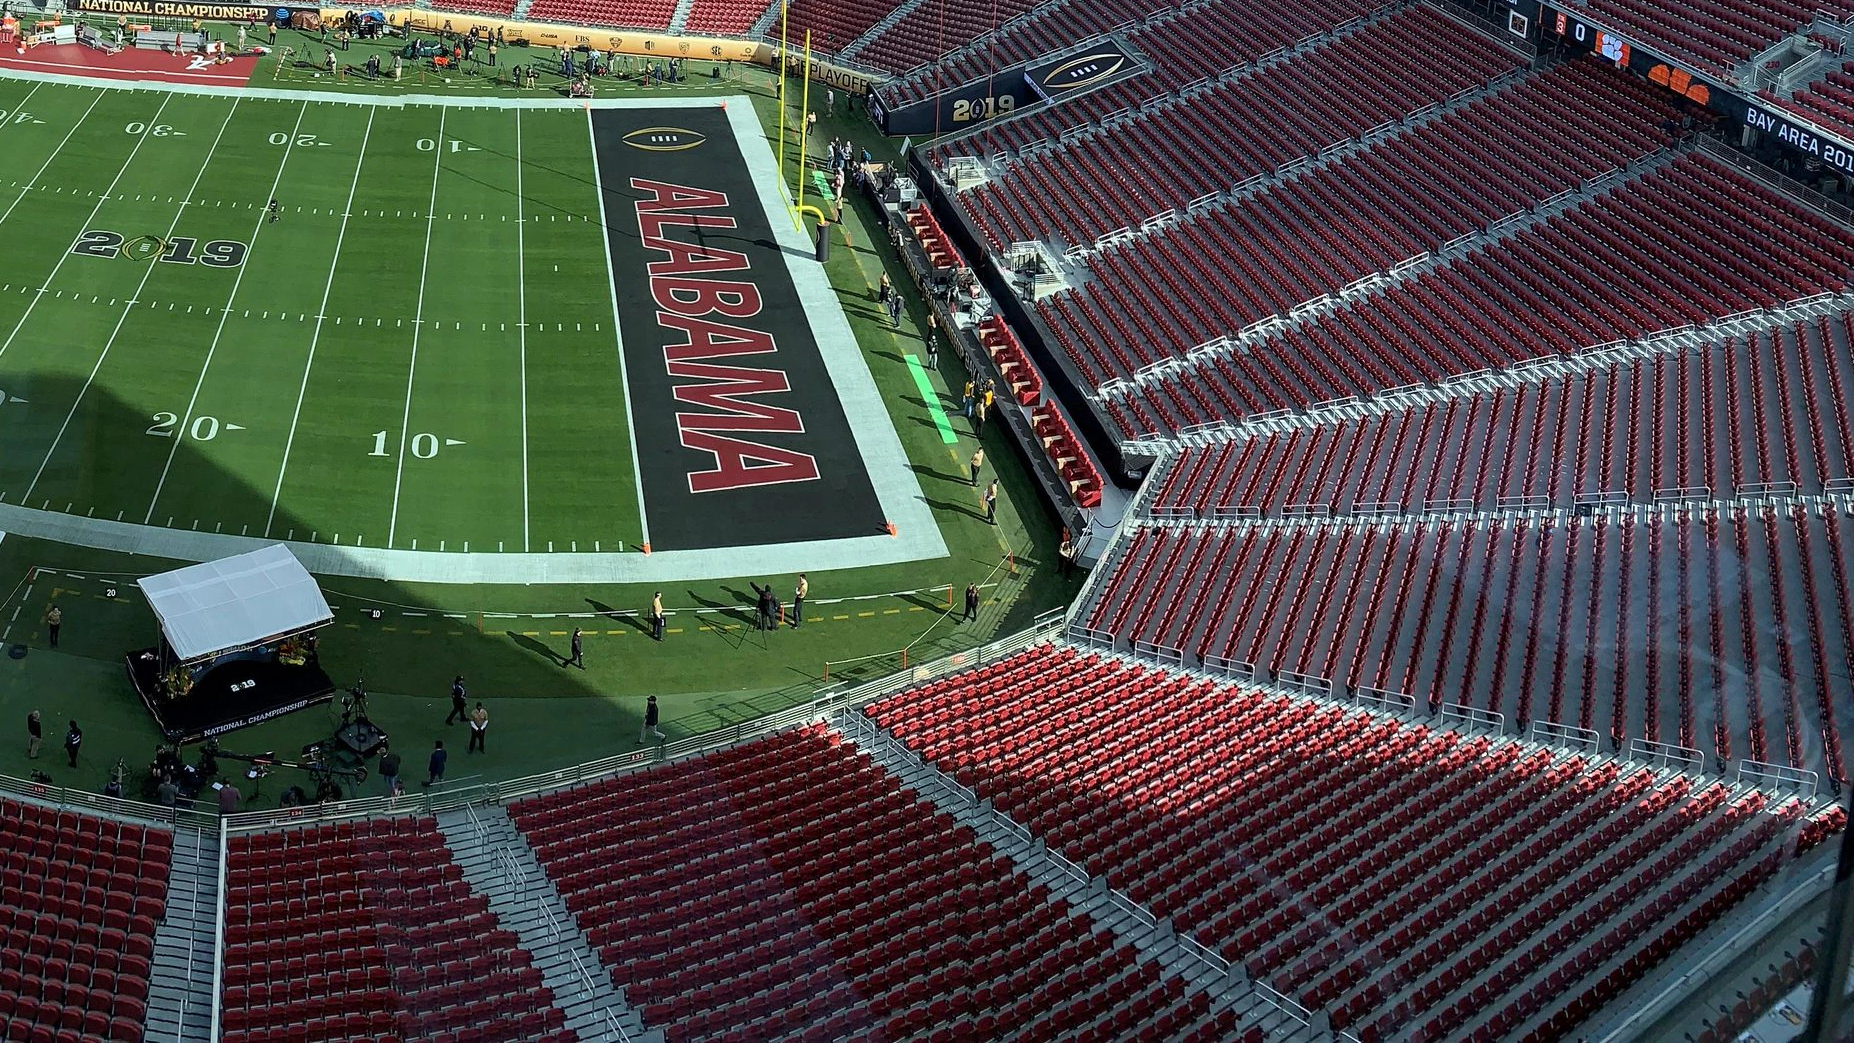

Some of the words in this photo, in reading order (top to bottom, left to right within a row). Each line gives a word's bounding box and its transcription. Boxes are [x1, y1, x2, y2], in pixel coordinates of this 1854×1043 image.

[154, 1, 269, 21] CHAMPIONSHIP
[1575, 22, 1586, 42] 0
[953, 93, 1015, 122] 2019
[1747, 107, 1776, 132] BAY
[1778, 123, 1819, 156] AREA
[70, 230, 248, 268] 2019
[629, 177, 822, 494] ALABAMA
[145, 411, 219, 441] 20
[367, 430, 439, 459] 10
[106, 588, 116, 598] 20
[372, 609, 381, 618] 10
[204, 719, 247, 738] NATIONAL
[248, 699, 307, 725] CHAMPIONSHIP
